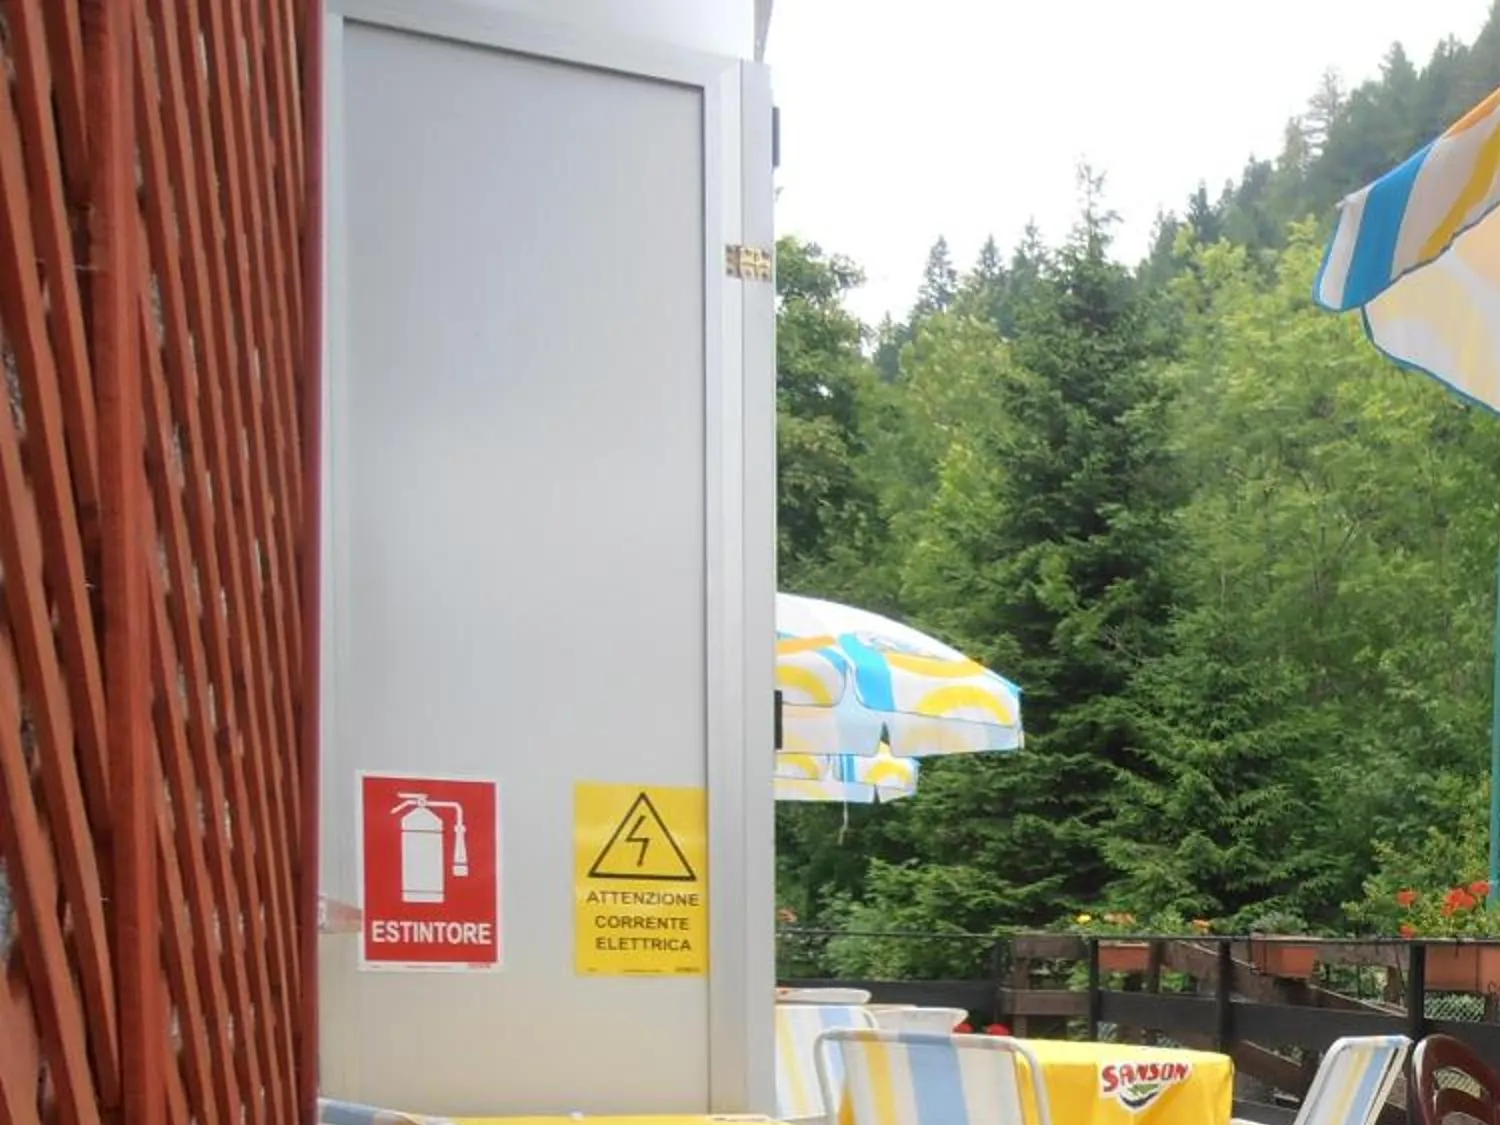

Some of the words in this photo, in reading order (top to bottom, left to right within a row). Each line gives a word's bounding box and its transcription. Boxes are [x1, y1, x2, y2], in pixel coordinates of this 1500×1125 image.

[586, 890, 700, 907] ATTENZIONE
[595, 915, 690, 931] CORRENTE
[372, 920, 493, 945] ESTINTORE
[595, 936, 692, 952] ELETTRICA
[1102, 1061, 1188, 1092] SANSON
